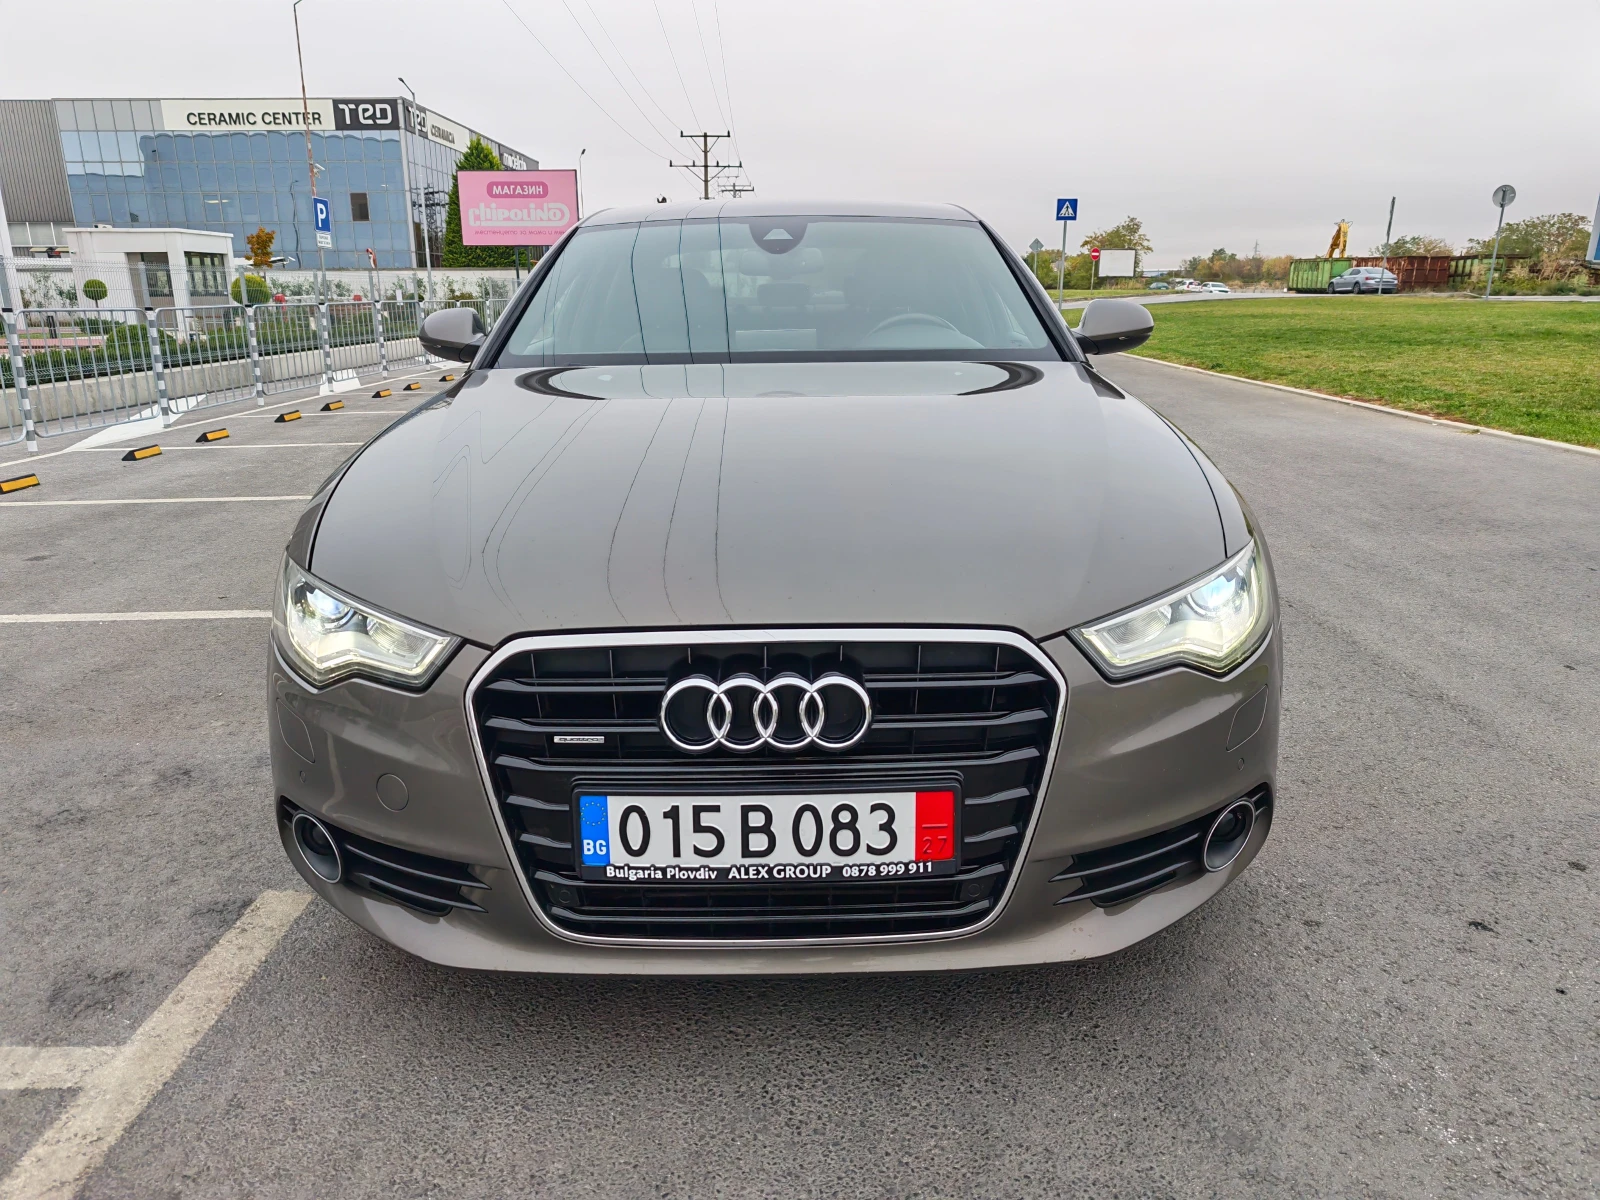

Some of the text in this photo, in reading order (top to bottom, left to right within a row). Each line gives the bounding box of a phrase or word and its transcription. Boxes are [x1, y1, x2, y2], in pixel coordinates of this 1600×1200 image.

[186, 112, 322, 126] CERAMIC CENTER
[492, 185, 543, 195] МАГАЗИН
[316, 202, 327, 228] P
[583, 839, 607, 855] BG
[921, 836, 948, 855] 27
[606, 861, 932, 880] Bulgaria Plovdiv ALEX GROUP 0878 999 911
